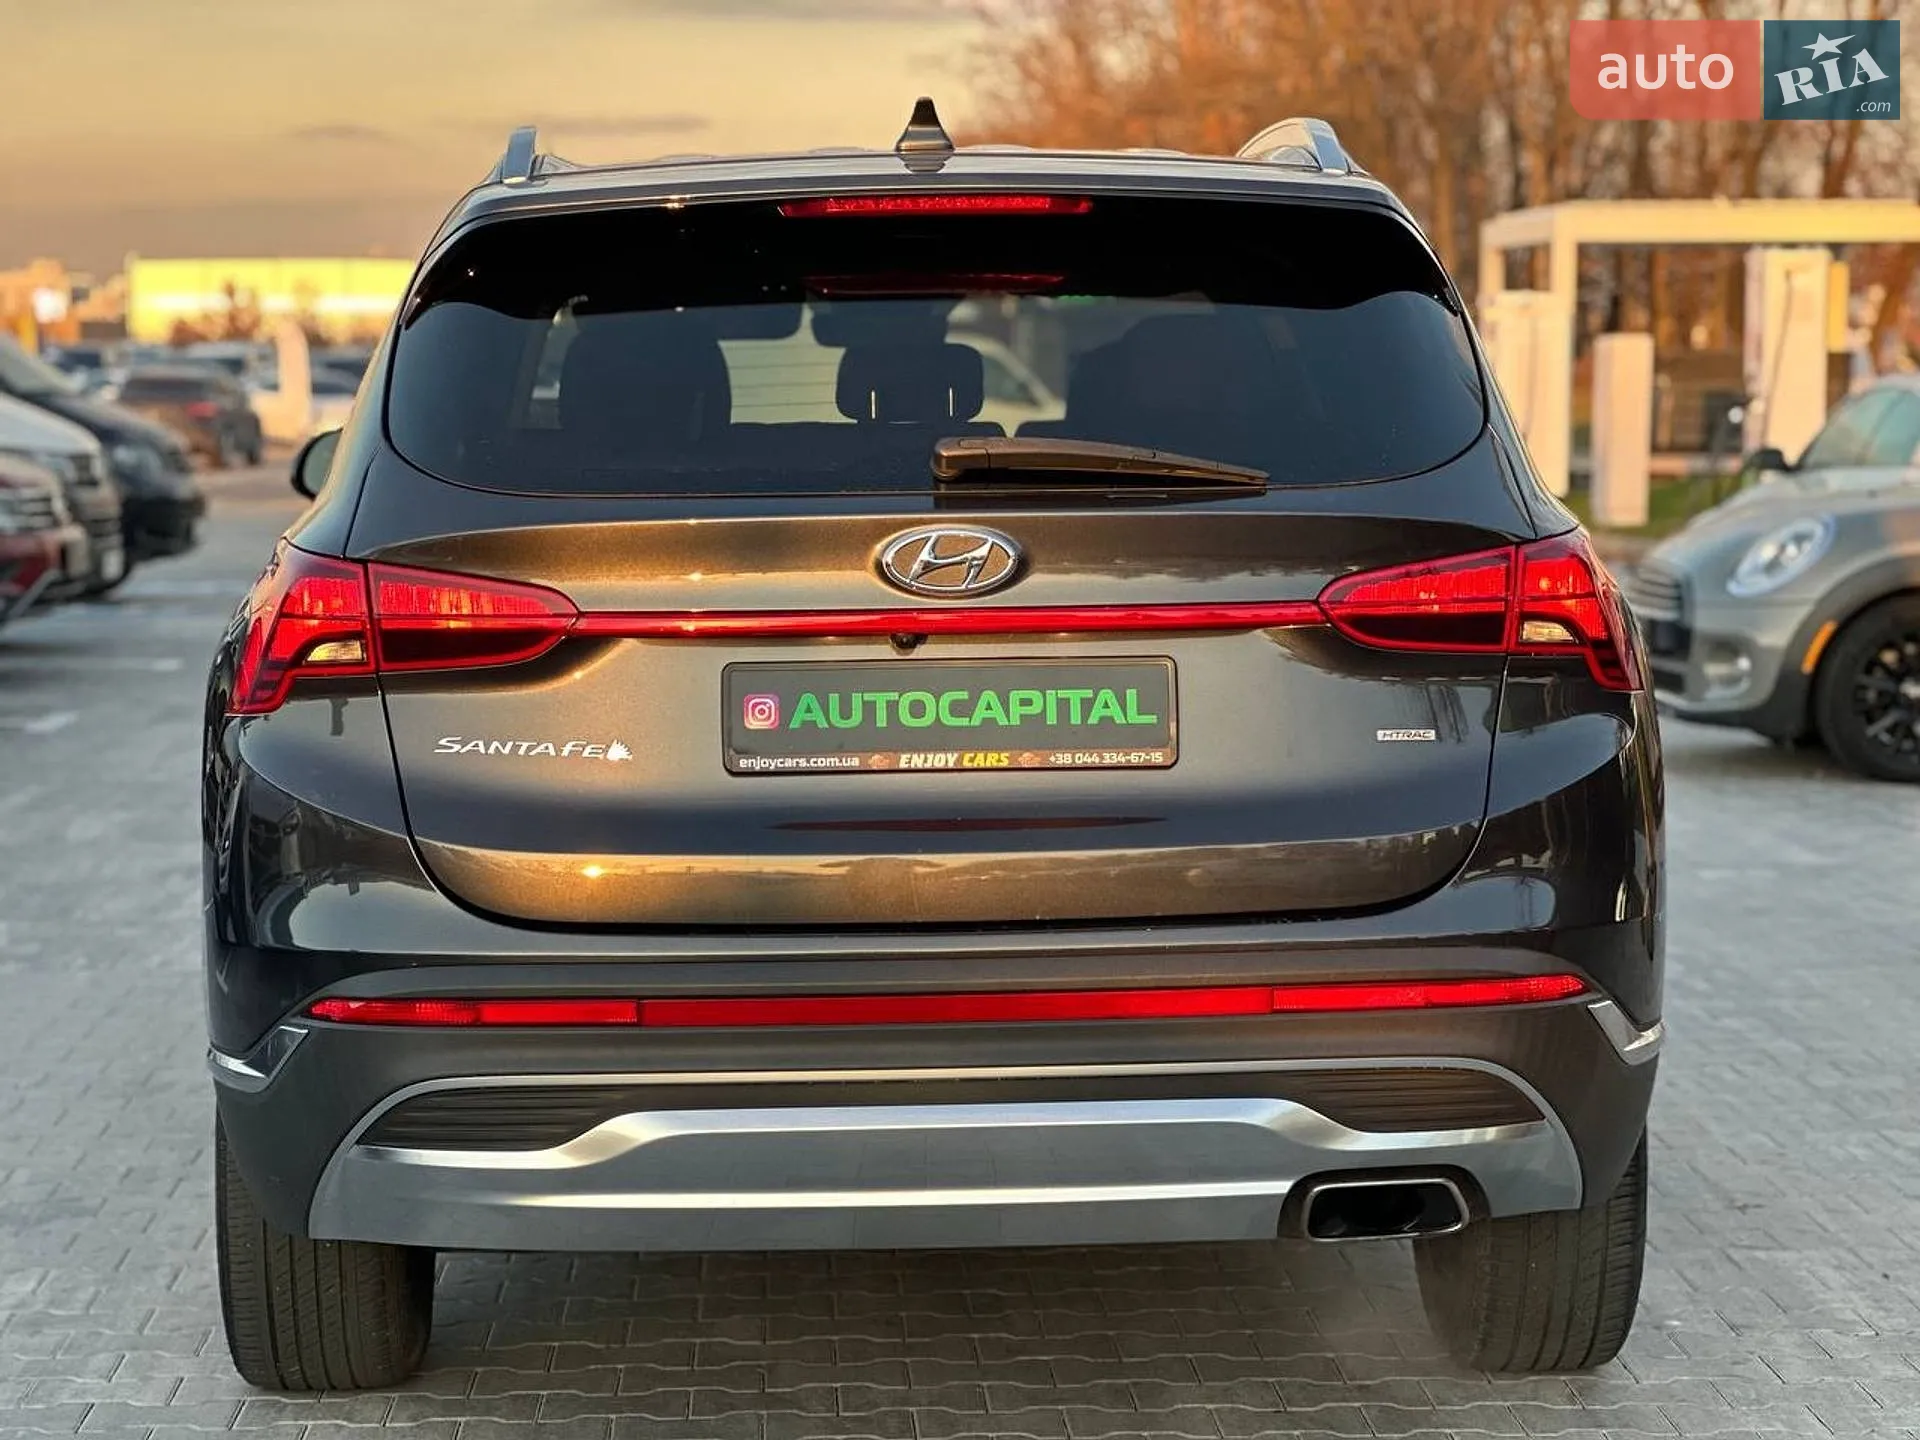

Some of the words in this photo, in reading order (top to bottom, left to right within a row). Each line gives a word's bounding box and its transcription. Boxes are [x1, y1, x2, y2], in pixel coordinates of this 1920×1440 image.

[789, 688, 1158, 729] AUTOCAPITAL
[434, 736, 556, 756] SANTA
[560, 741, 606, 760] FE
[739, 755, 860, 770] enjoycars.com.ua
[899, 753, 959, 769] ENJOY
[962, 752, 1010, 767] CARS
[1049, 752, 1073, 764] +38
[1075, 752, 1100, 765] 044
[1102, 751, 1164, 764] 334-67-15
